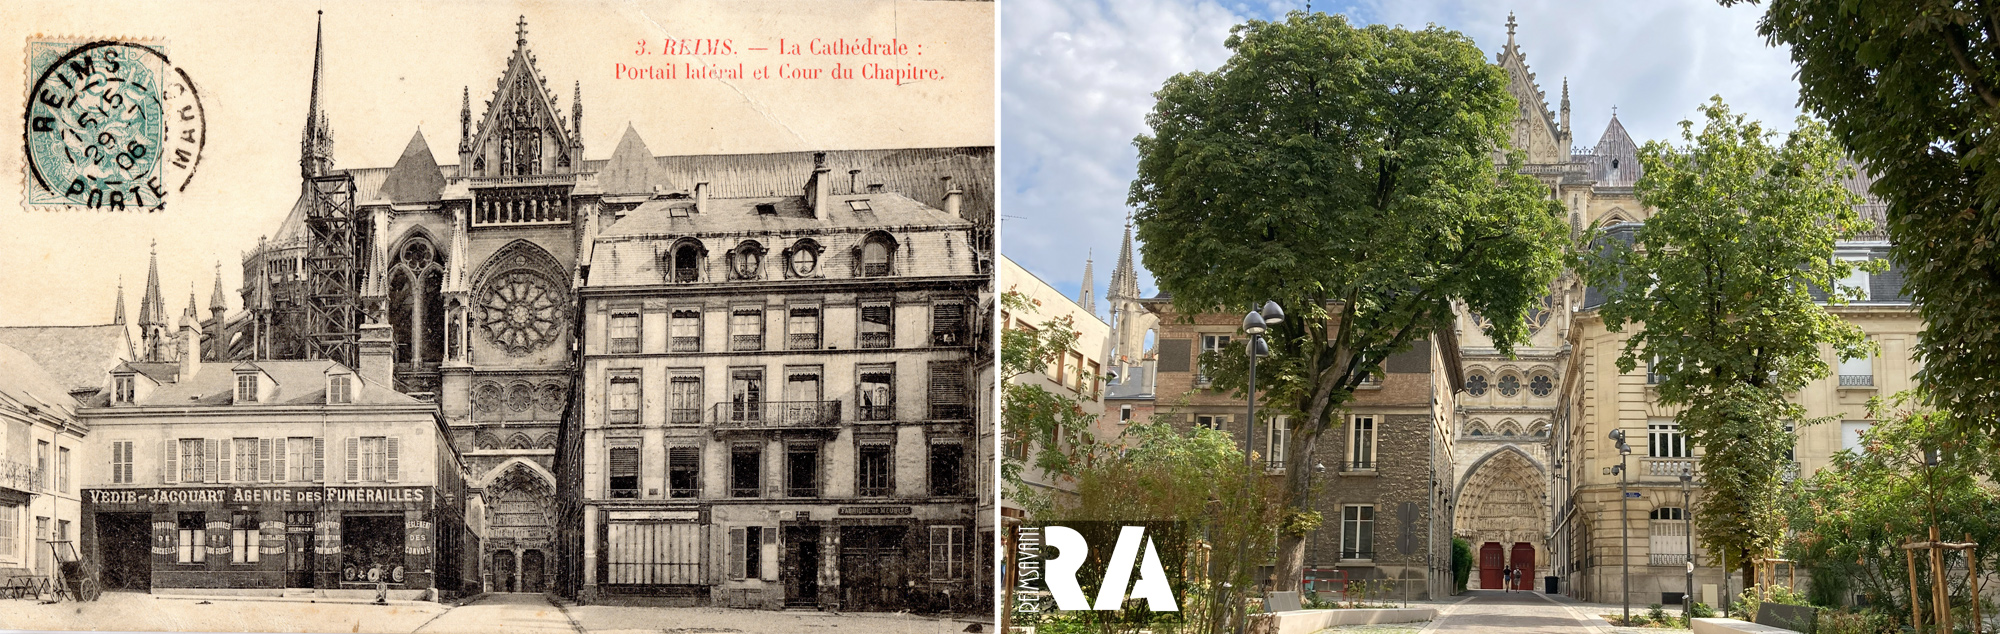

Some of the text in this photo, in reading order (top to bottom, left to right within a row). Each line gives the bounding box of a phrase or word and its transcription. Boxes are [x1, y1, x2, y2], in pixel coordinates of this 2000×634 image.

[33, 50, 120, 132] REIMS
[234, 488, 292, 502] AGENCE
[297, 491, 322, 502] DES
[326, 487, 424, 502] FUNÉRAILLES
